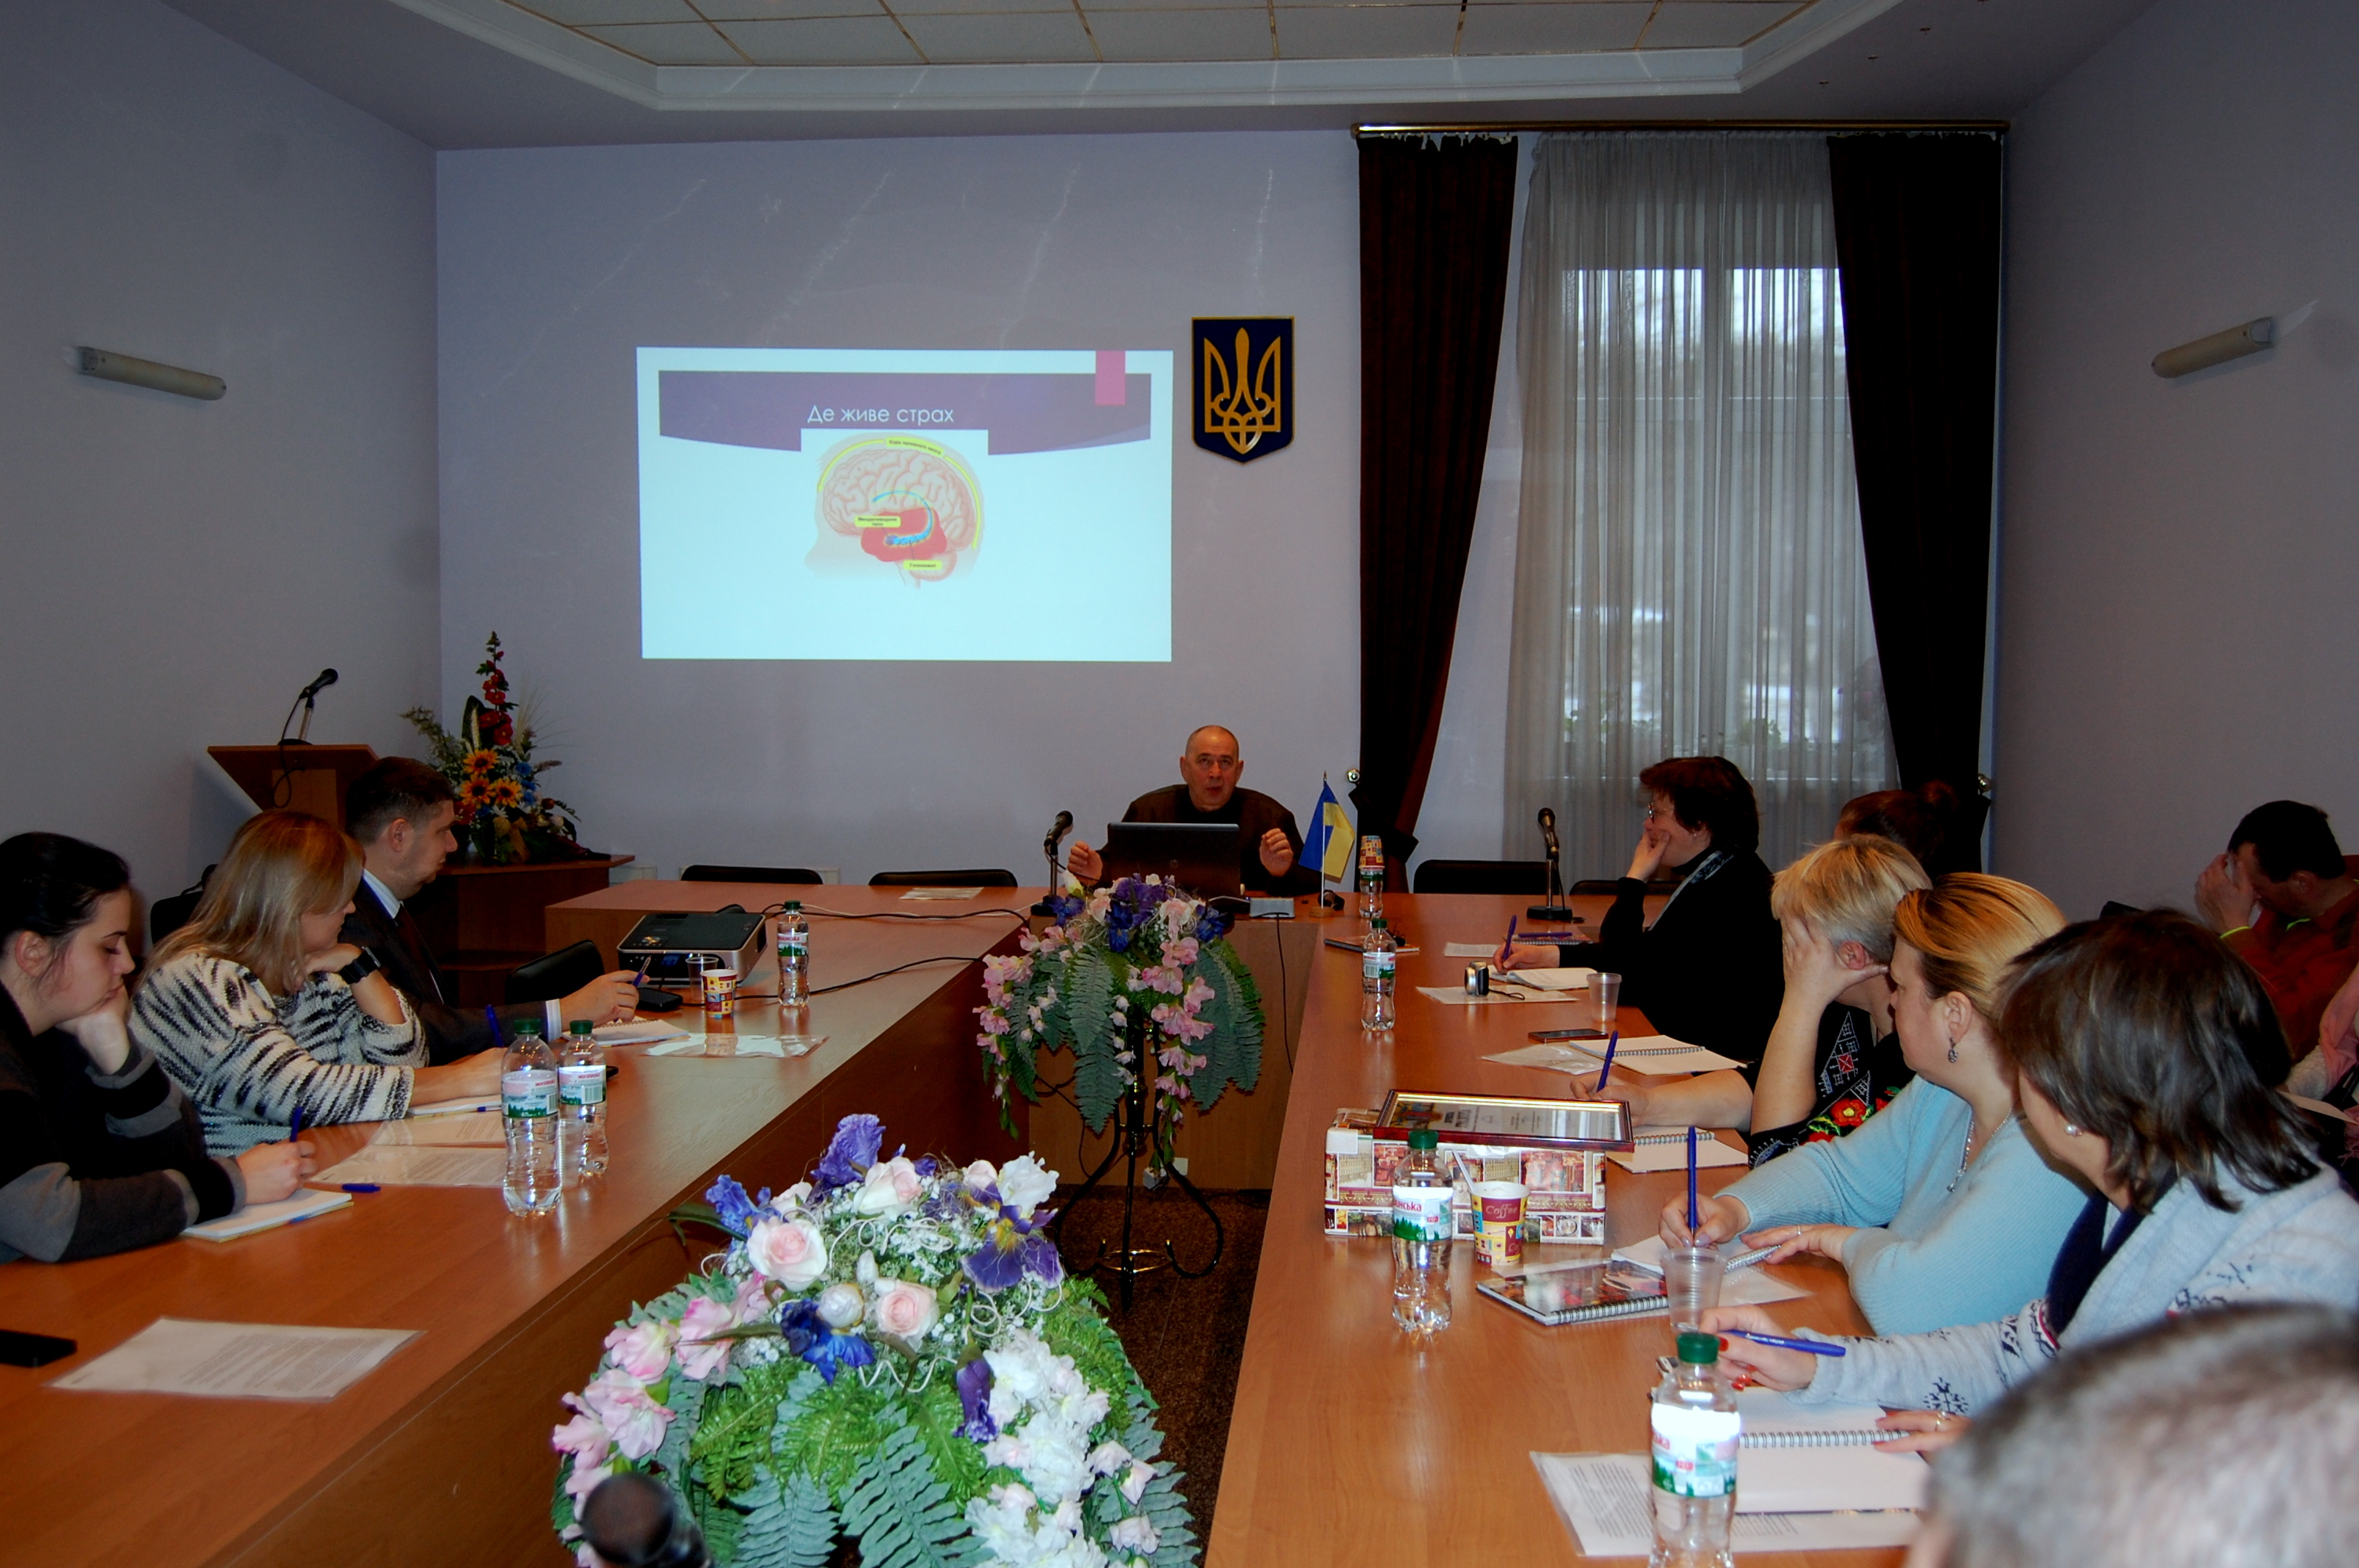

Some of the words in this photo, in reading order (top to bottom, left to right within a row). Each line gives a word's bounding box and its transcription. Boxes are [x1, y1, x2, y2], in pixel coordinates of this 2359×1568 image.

[807, 405, 834, 423] Де
[841, 408, 890, 423] живе
[896, 408, 954, 426] страх
[1485, 1203, 1518, 1219] Coffee
